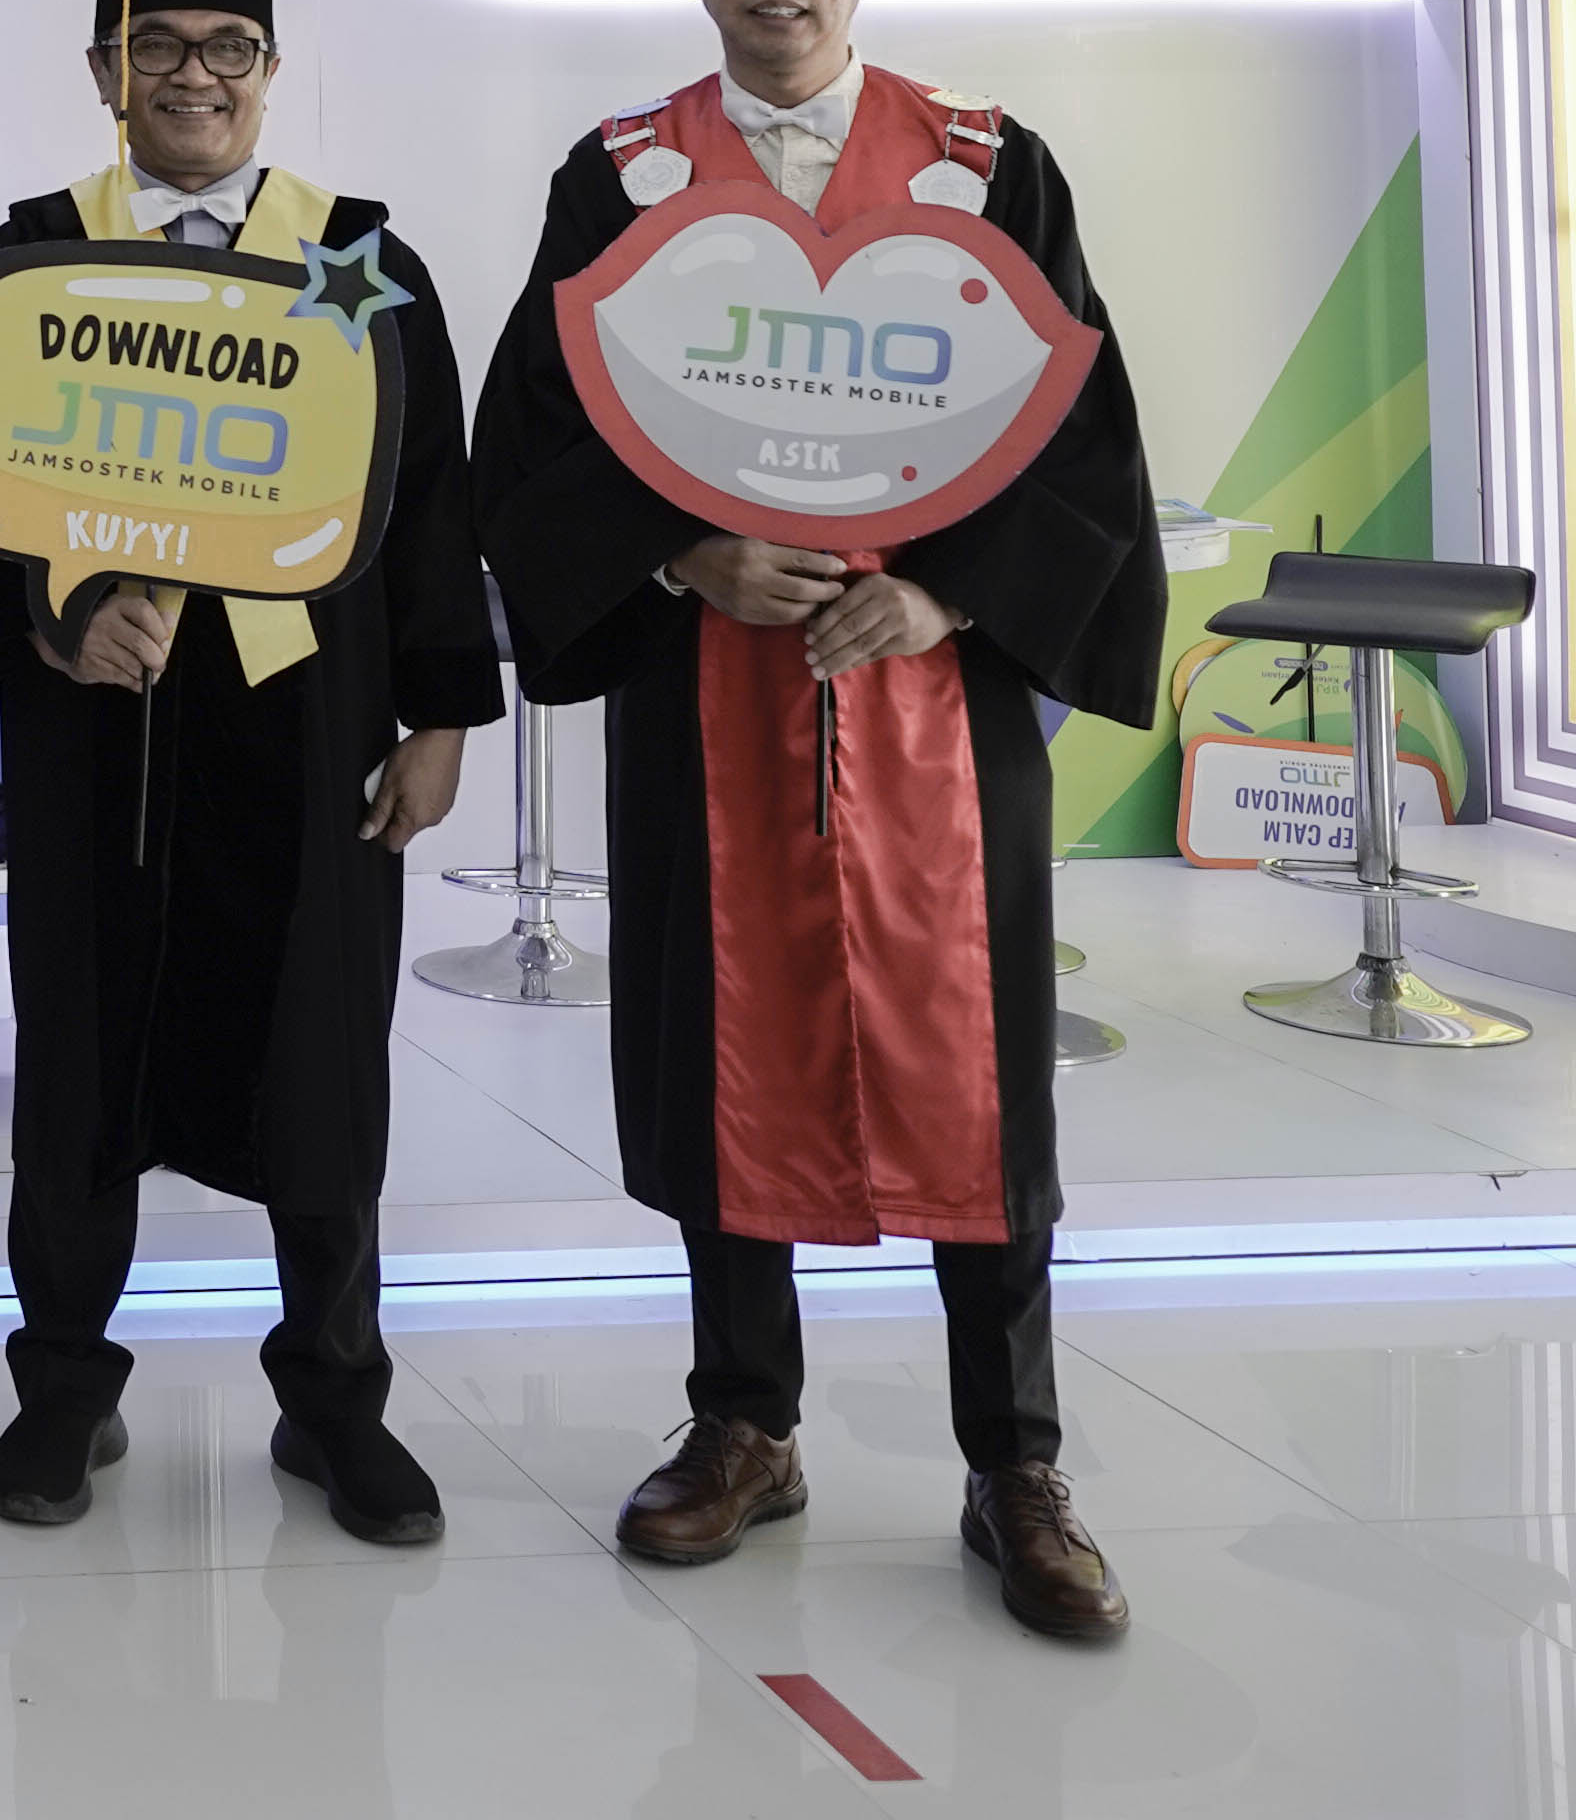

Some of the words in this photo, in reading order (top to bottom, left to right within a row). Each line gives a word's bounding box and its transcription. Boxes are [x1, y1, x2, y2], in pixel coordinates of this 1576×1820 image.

[39, 313, 300, 390] DOWNLOAD
[685, 304, 953, 387] JMO
[682, 367, 835, 397] JAMSOSTEK
[849, 385, 948, 409] MOBILE
[10, 380, 290, 477] JMO
[7, 448, 165, 485] JAMSOSTEK
[179, 473, 282, 503] MOBILE
[759, 439, 842, 474] ASIK
[66, 509, 191, 566] KUYY!
[1235, 786, 1356, 819] DOWNLOAD
[1263, 820, 1322, 847] CALM
